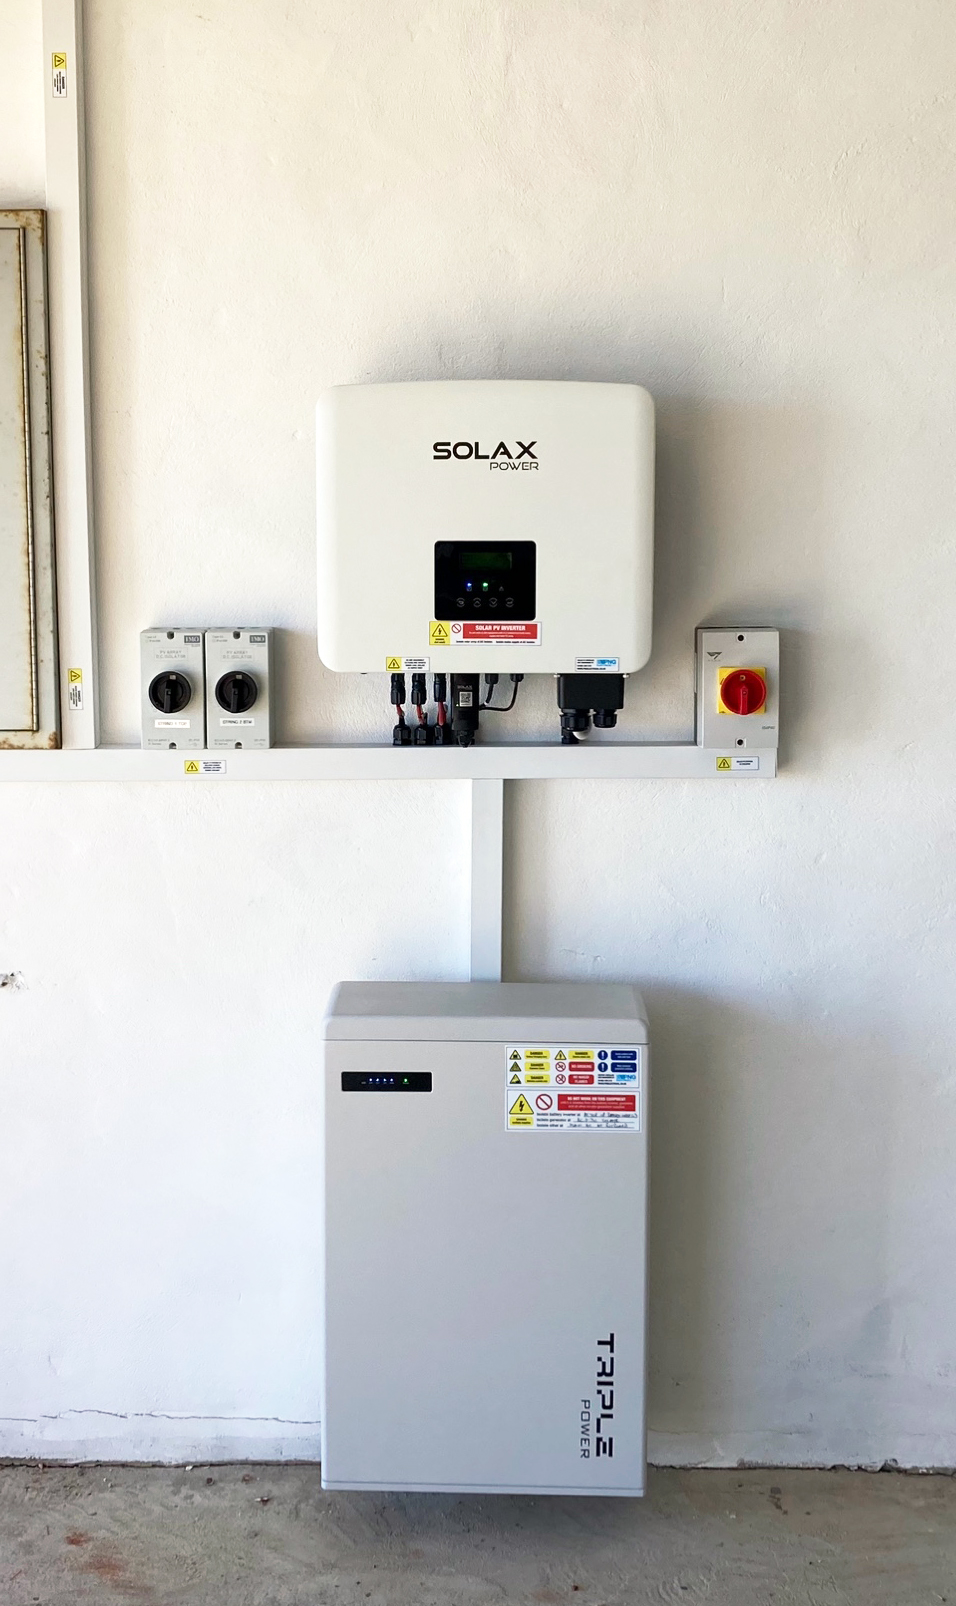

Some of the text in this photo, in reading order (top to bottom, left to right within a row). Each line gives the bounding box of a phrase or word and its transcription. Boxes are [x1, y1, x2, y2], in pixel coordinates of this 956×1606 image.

[432, 441, 538, 460] SOLAX
[489, 461, 540, 471] POWER
[186, 635, 200, 643] IMO
[596, 1333, 615, 1457] TRIPLE
[580, 1399, 591, 1459] POWER
